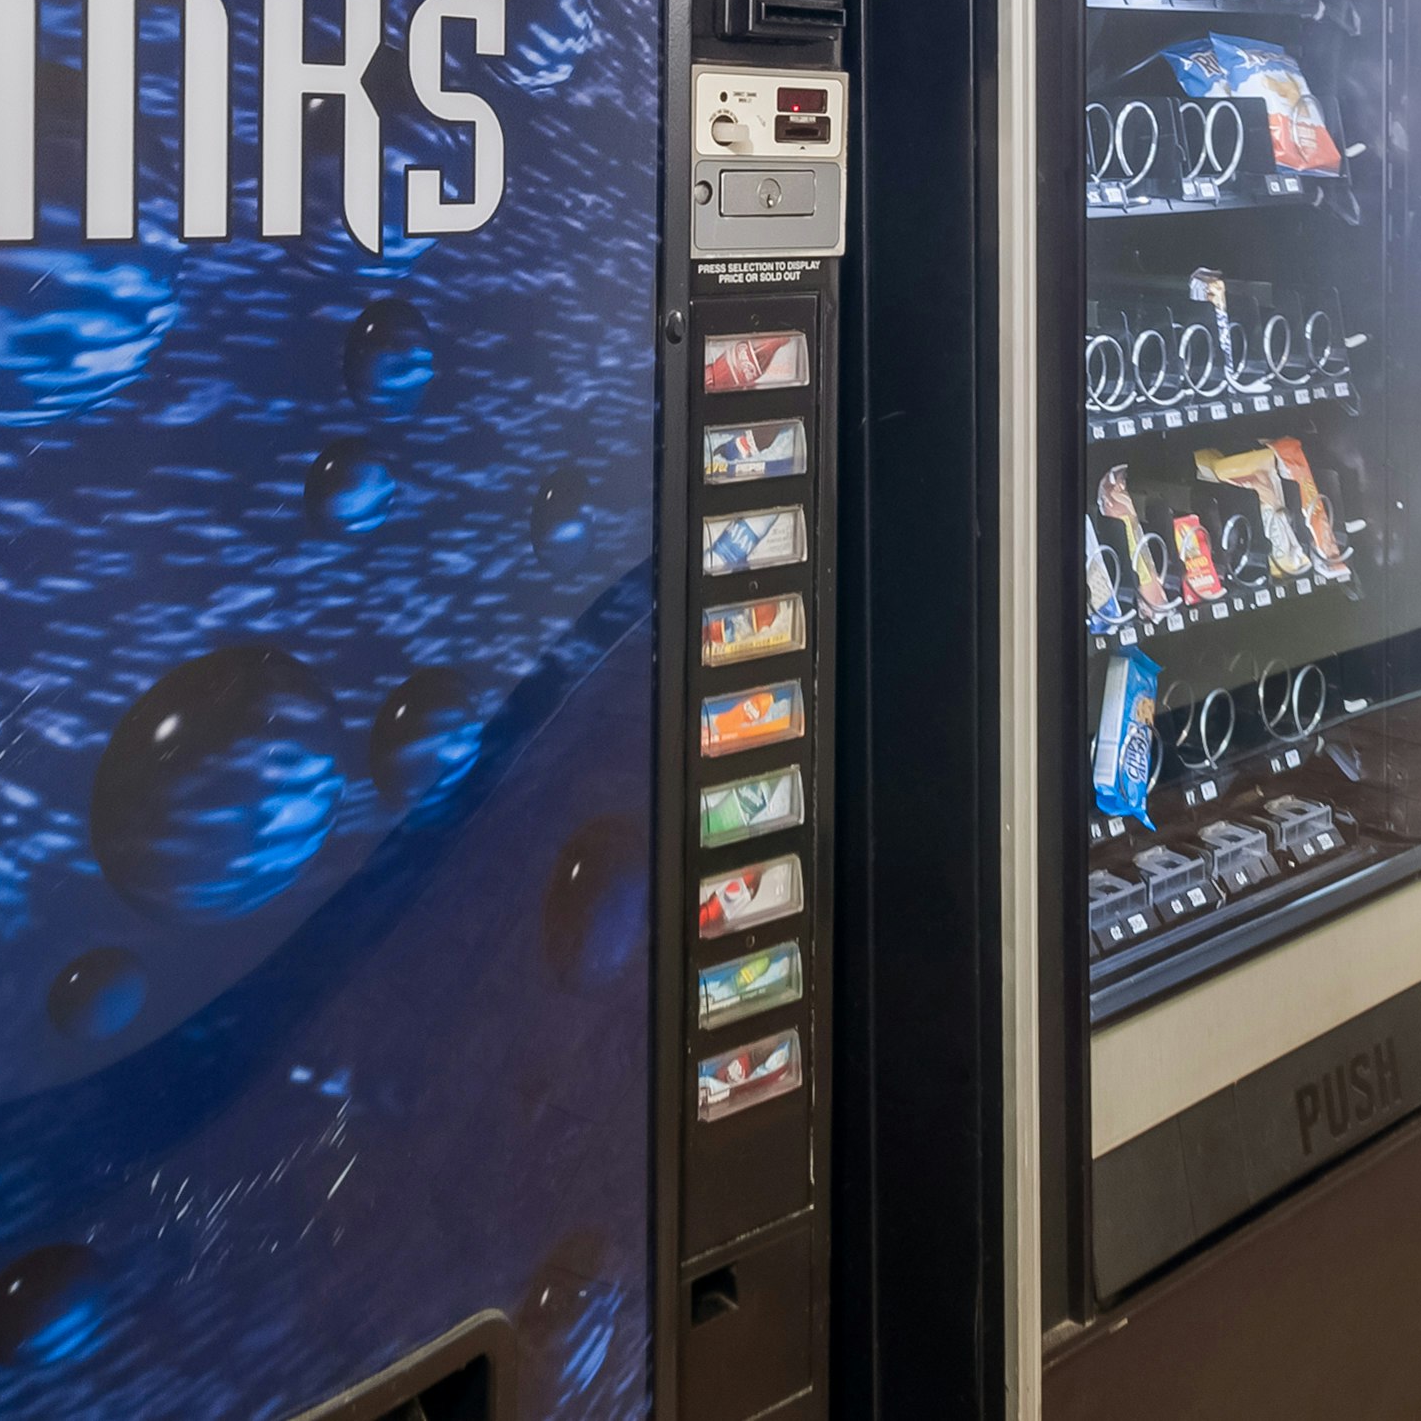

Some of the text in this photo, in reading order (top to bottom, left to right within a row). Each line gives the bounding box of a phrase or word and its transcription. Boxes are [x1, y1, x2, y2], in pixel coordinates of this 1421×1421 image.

[698, 260, 821, 274] PRESS SELECTION TO DISPLAY
[718, 271, 801, 284] PRICE OR SOLD OUT
[1296, 1037, 1402, 1156] PUSH
